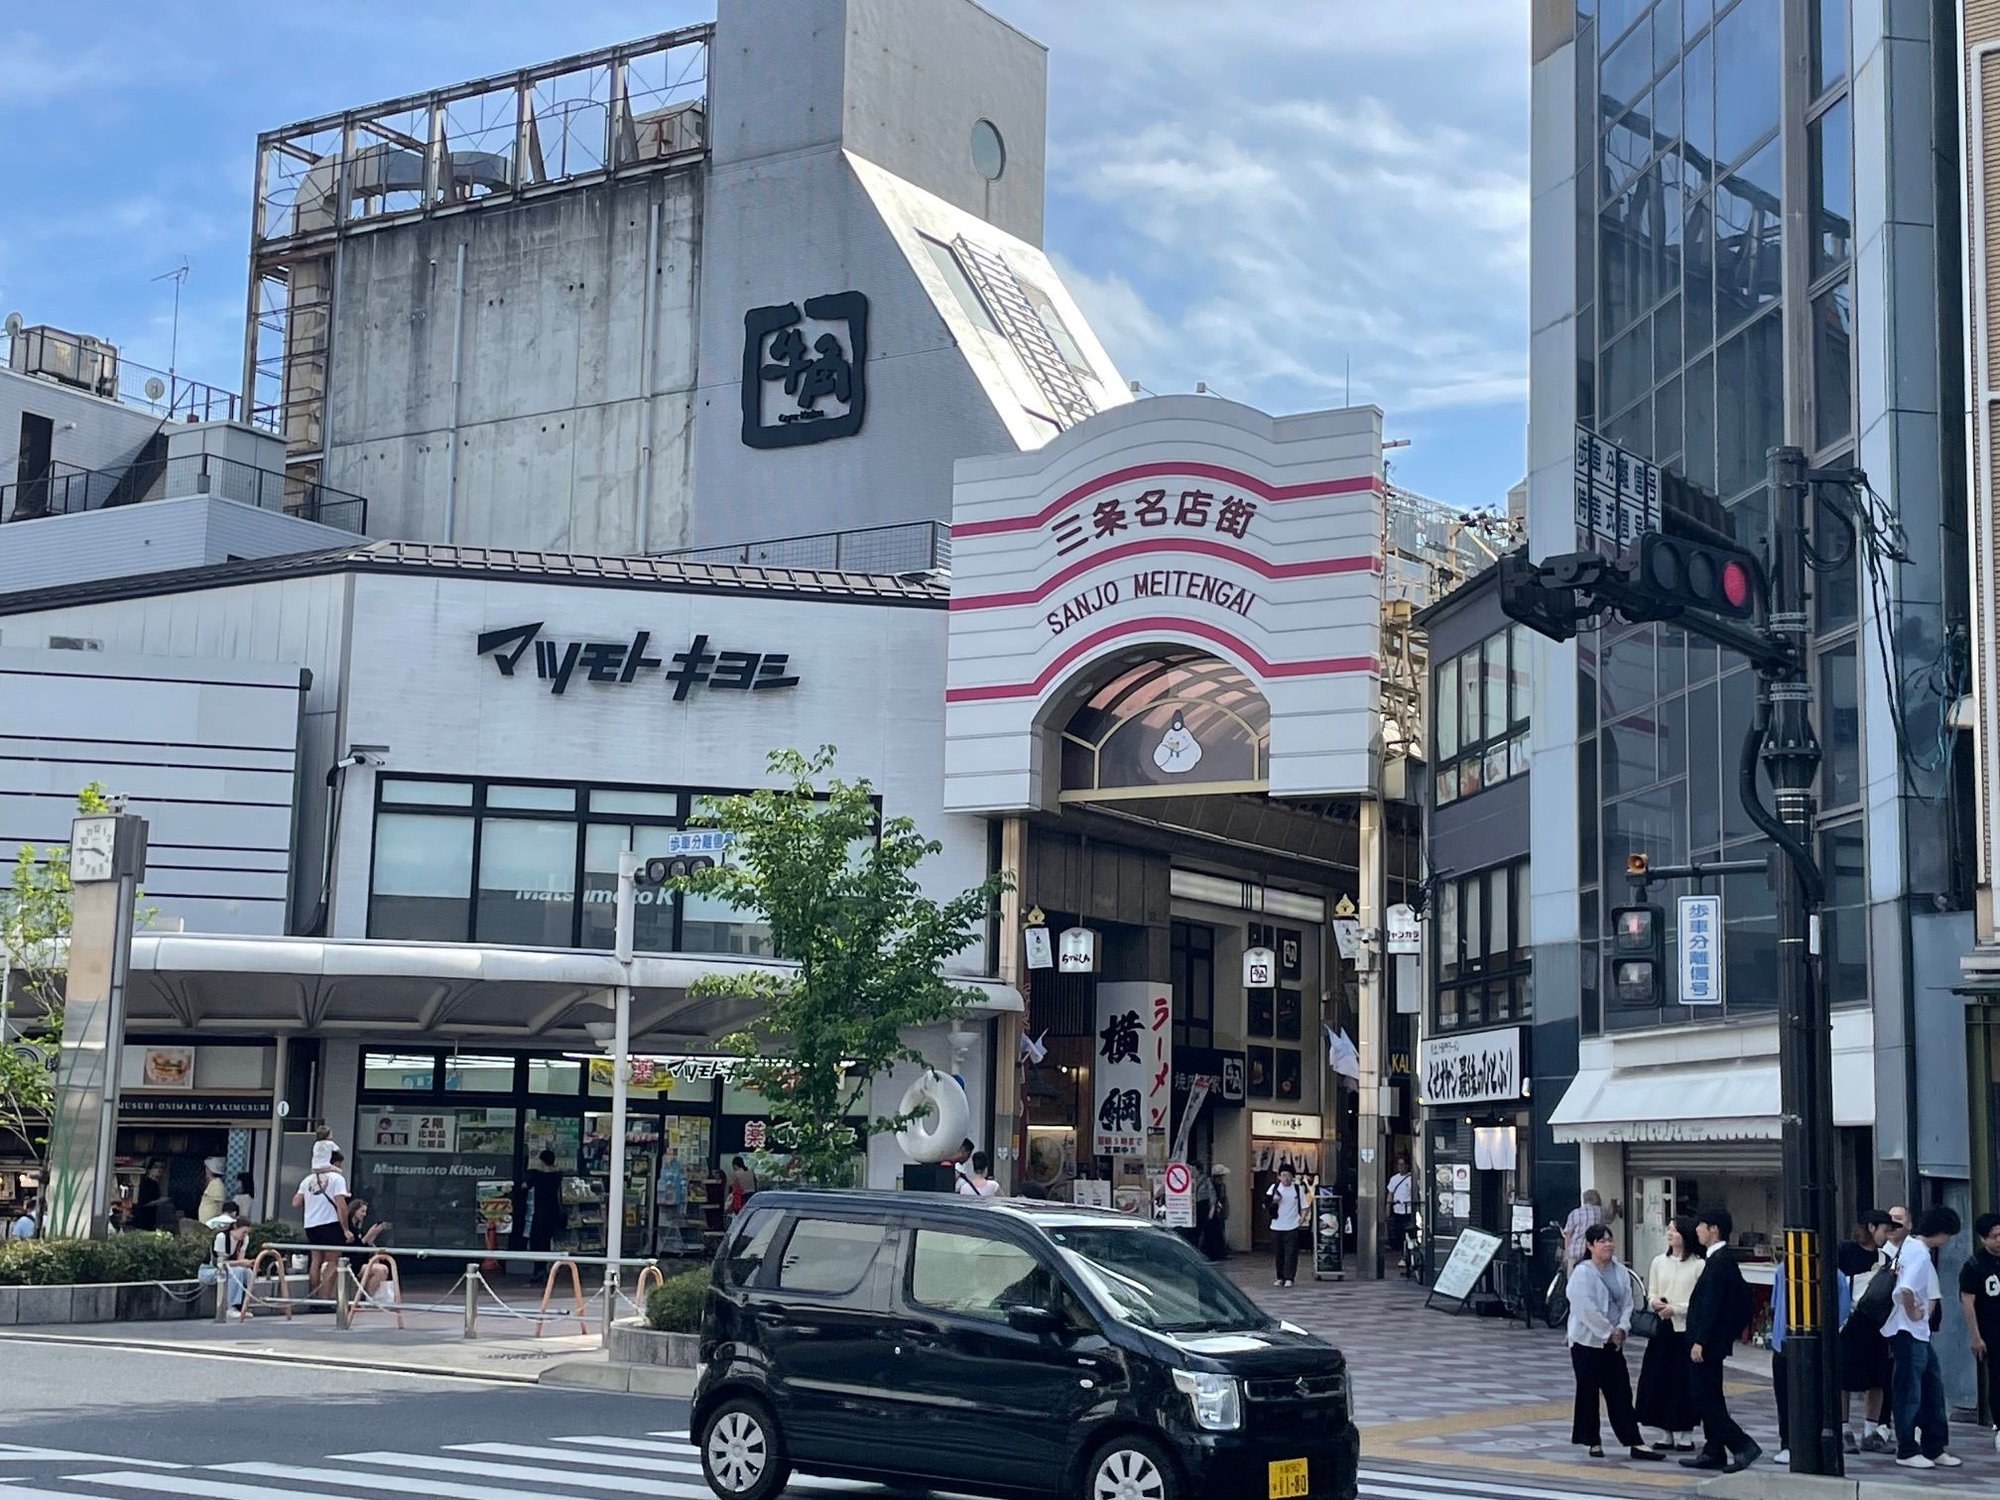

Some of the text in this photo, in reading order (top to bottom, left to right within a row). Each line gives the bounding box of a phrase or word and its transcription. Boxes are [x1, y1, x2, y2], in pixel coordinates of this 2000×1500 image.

[1050, 488, 1258, 557] 三条名店街
[1046, 569, 1257, 635] SANJO MEITENGAI
[477, 621, 801, 701] マツモトキヨシ
[1689, 903, 1710, 997] 歩車分離信号
[632, 1059, 654, 1084] 薬
[1099, 1009, 1146, 1132] 横綱
[1150, 997, 1170, 1127] ラーメン
[744, 1120, 766, 1148] 薬
[373, 1163, 496, 1177] Matsumoto KiYoshi
